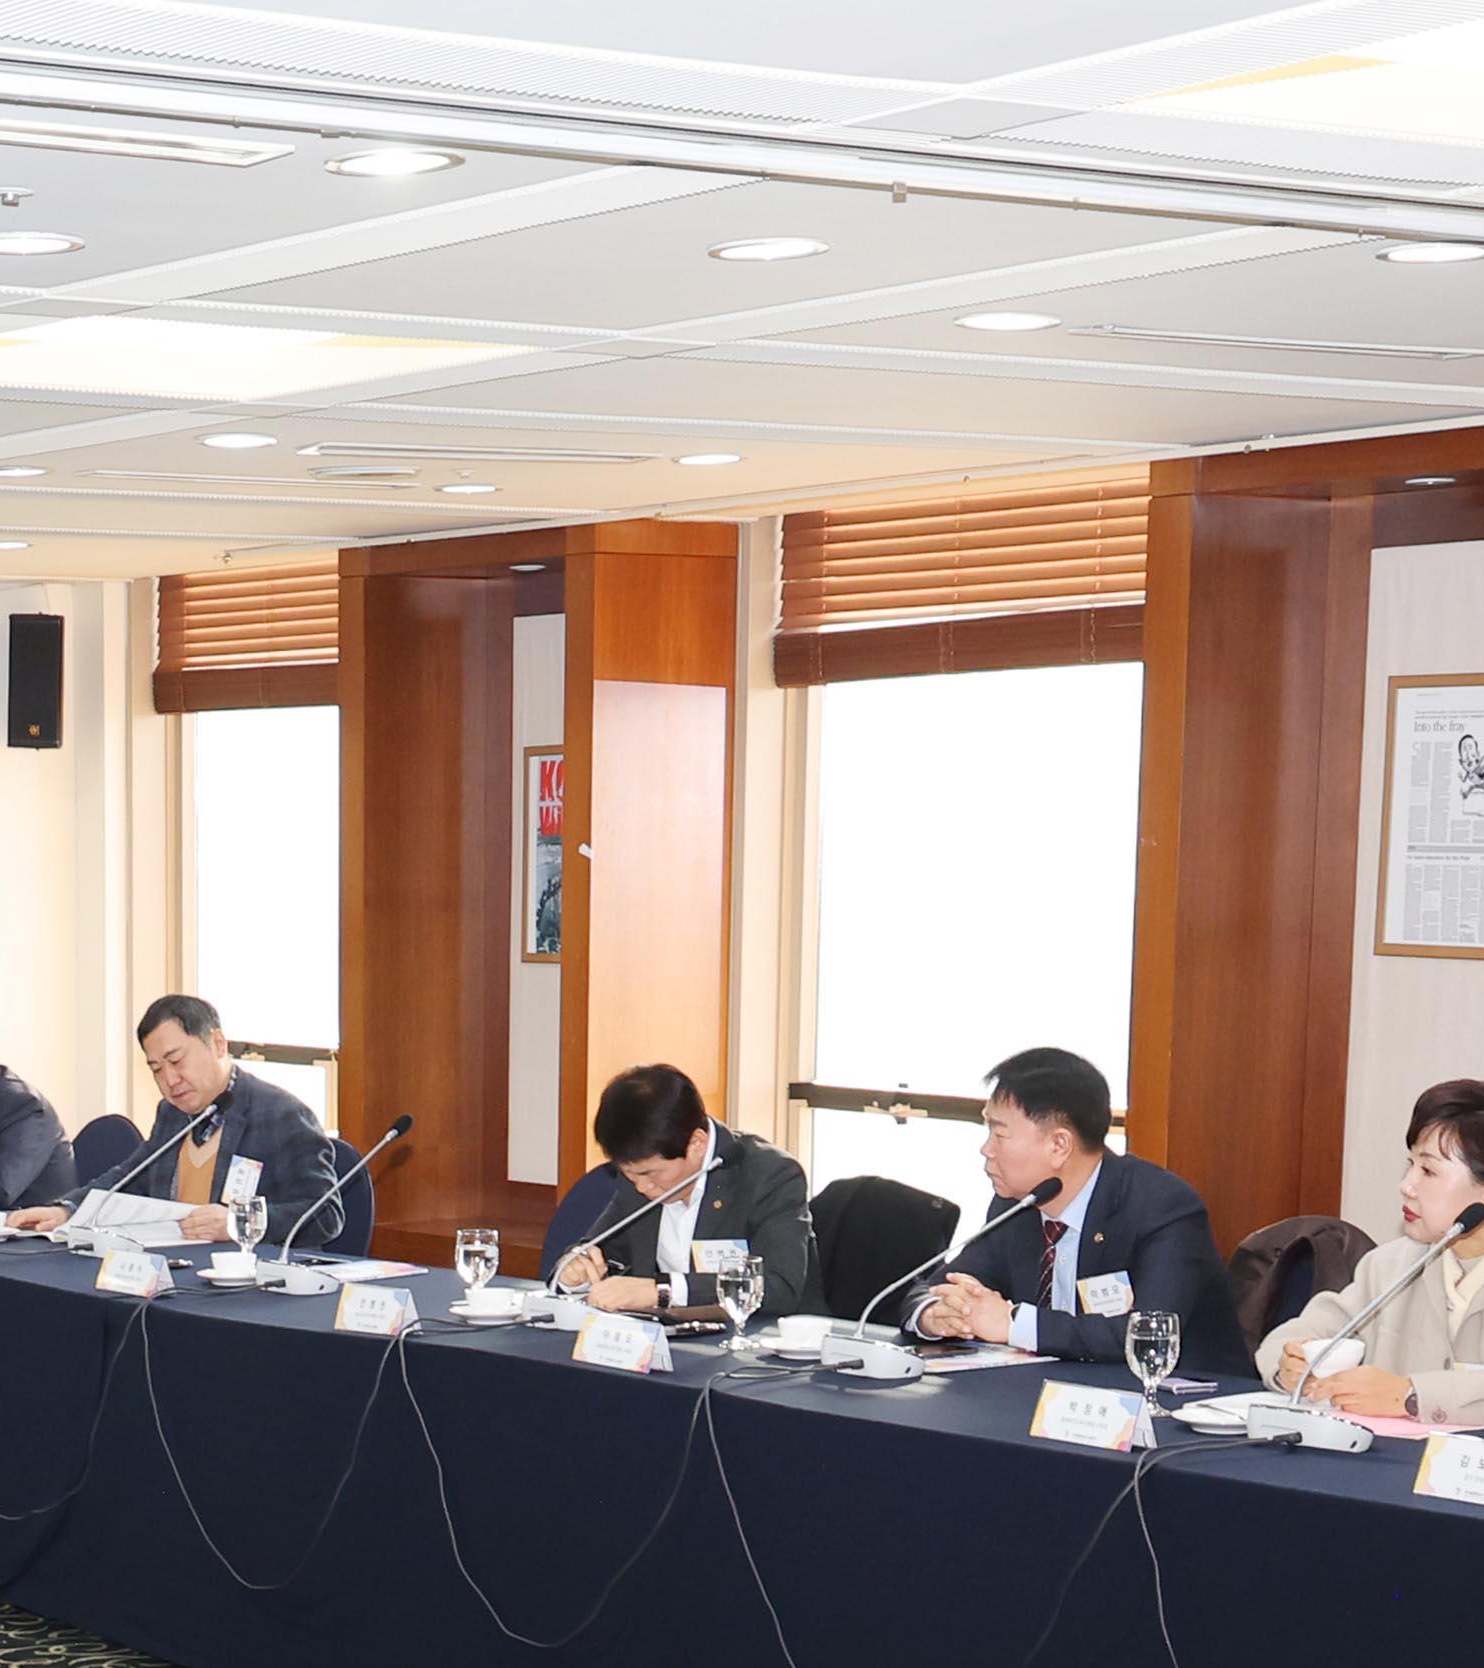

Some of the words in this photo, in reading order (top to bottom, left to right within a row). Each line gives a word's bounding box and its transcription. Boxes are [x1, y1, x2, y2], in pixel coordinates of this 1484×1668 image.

[1414, 721, 1431, 733] Into
[1433, 720, 1447, 732] the
[1449, 720, 1466, 733] fray
